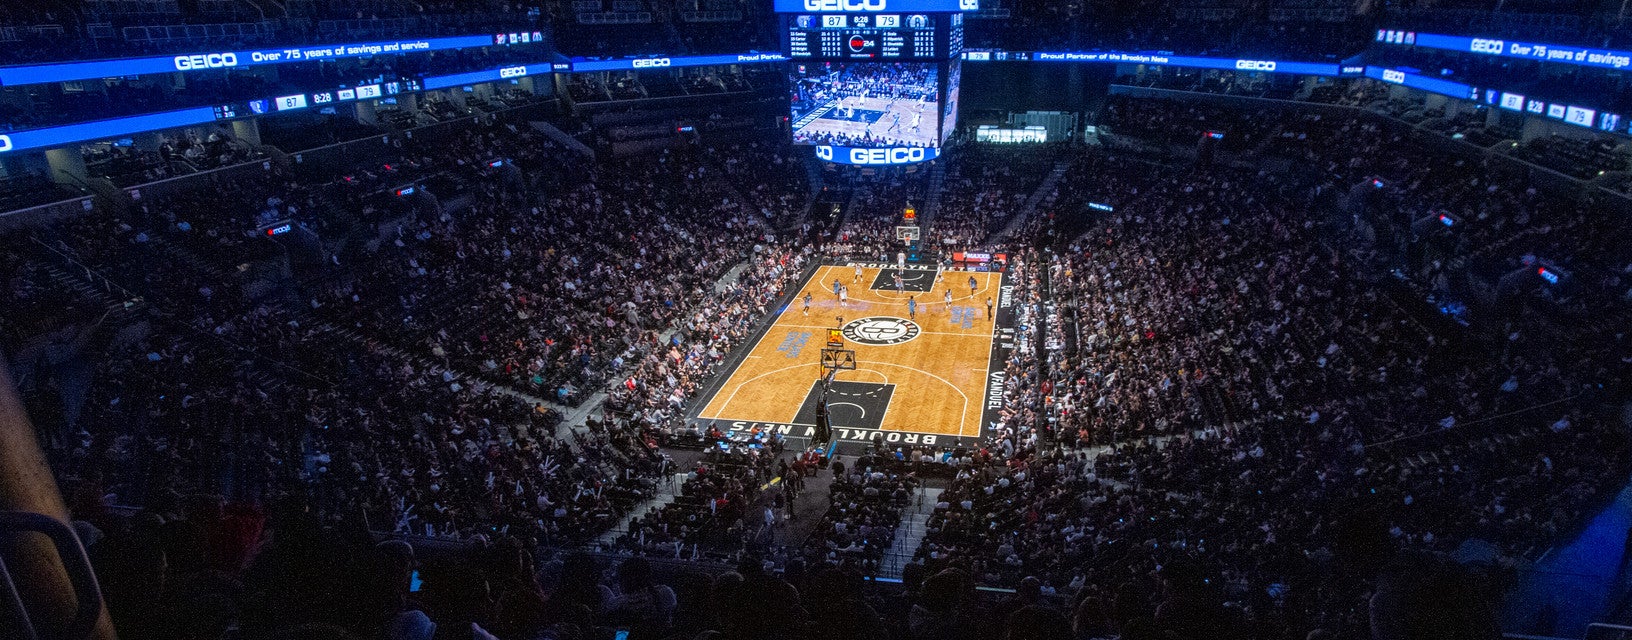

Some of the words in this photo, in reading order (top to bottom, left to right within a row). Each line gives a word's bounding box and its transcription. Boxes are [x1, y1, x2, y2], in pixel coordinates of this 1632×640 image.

[828, 16, 841, 26] 87
[880, 16, 895, 26] 79
[174, 52, 238, 71] GEICO
[252, 51, 281, 62] Over
[283, 49, 301, 59] 75
[303, 47, 333, 59] years
[335, 46, 345, 55] of
[347, 43, 382, 55] savings
[384, 42, 400, 51] and
[401, 41, 429, 50] service
[1121, 54, 1150, 62] Brooklyn
[1151, 55, 1169, 63] Nets
[1471, 38, 1504, 55] GEICO
[1510, 43, 1531, 54] Over
[1532, 45, 1546, 57] 75
[1547, 48, 1573, 61] years
[1575, 50, 1586, 62] of
[1588, 52, 1630, 68] savings
[632, 58, 671, 68] GEICO
[1236, 60, 1276, 71] GEICO
[500, 66, 526, 78] GEICO
[364, 87, 374, 96] 79
[286, 97, 297, 108] 87
[314, 93, 332, 103] 8:28
[1575, 110, 1586, 122] 79
[849, 147, 924, 164] GEICO
[988, 378, 1004, 410] FANDUEL
